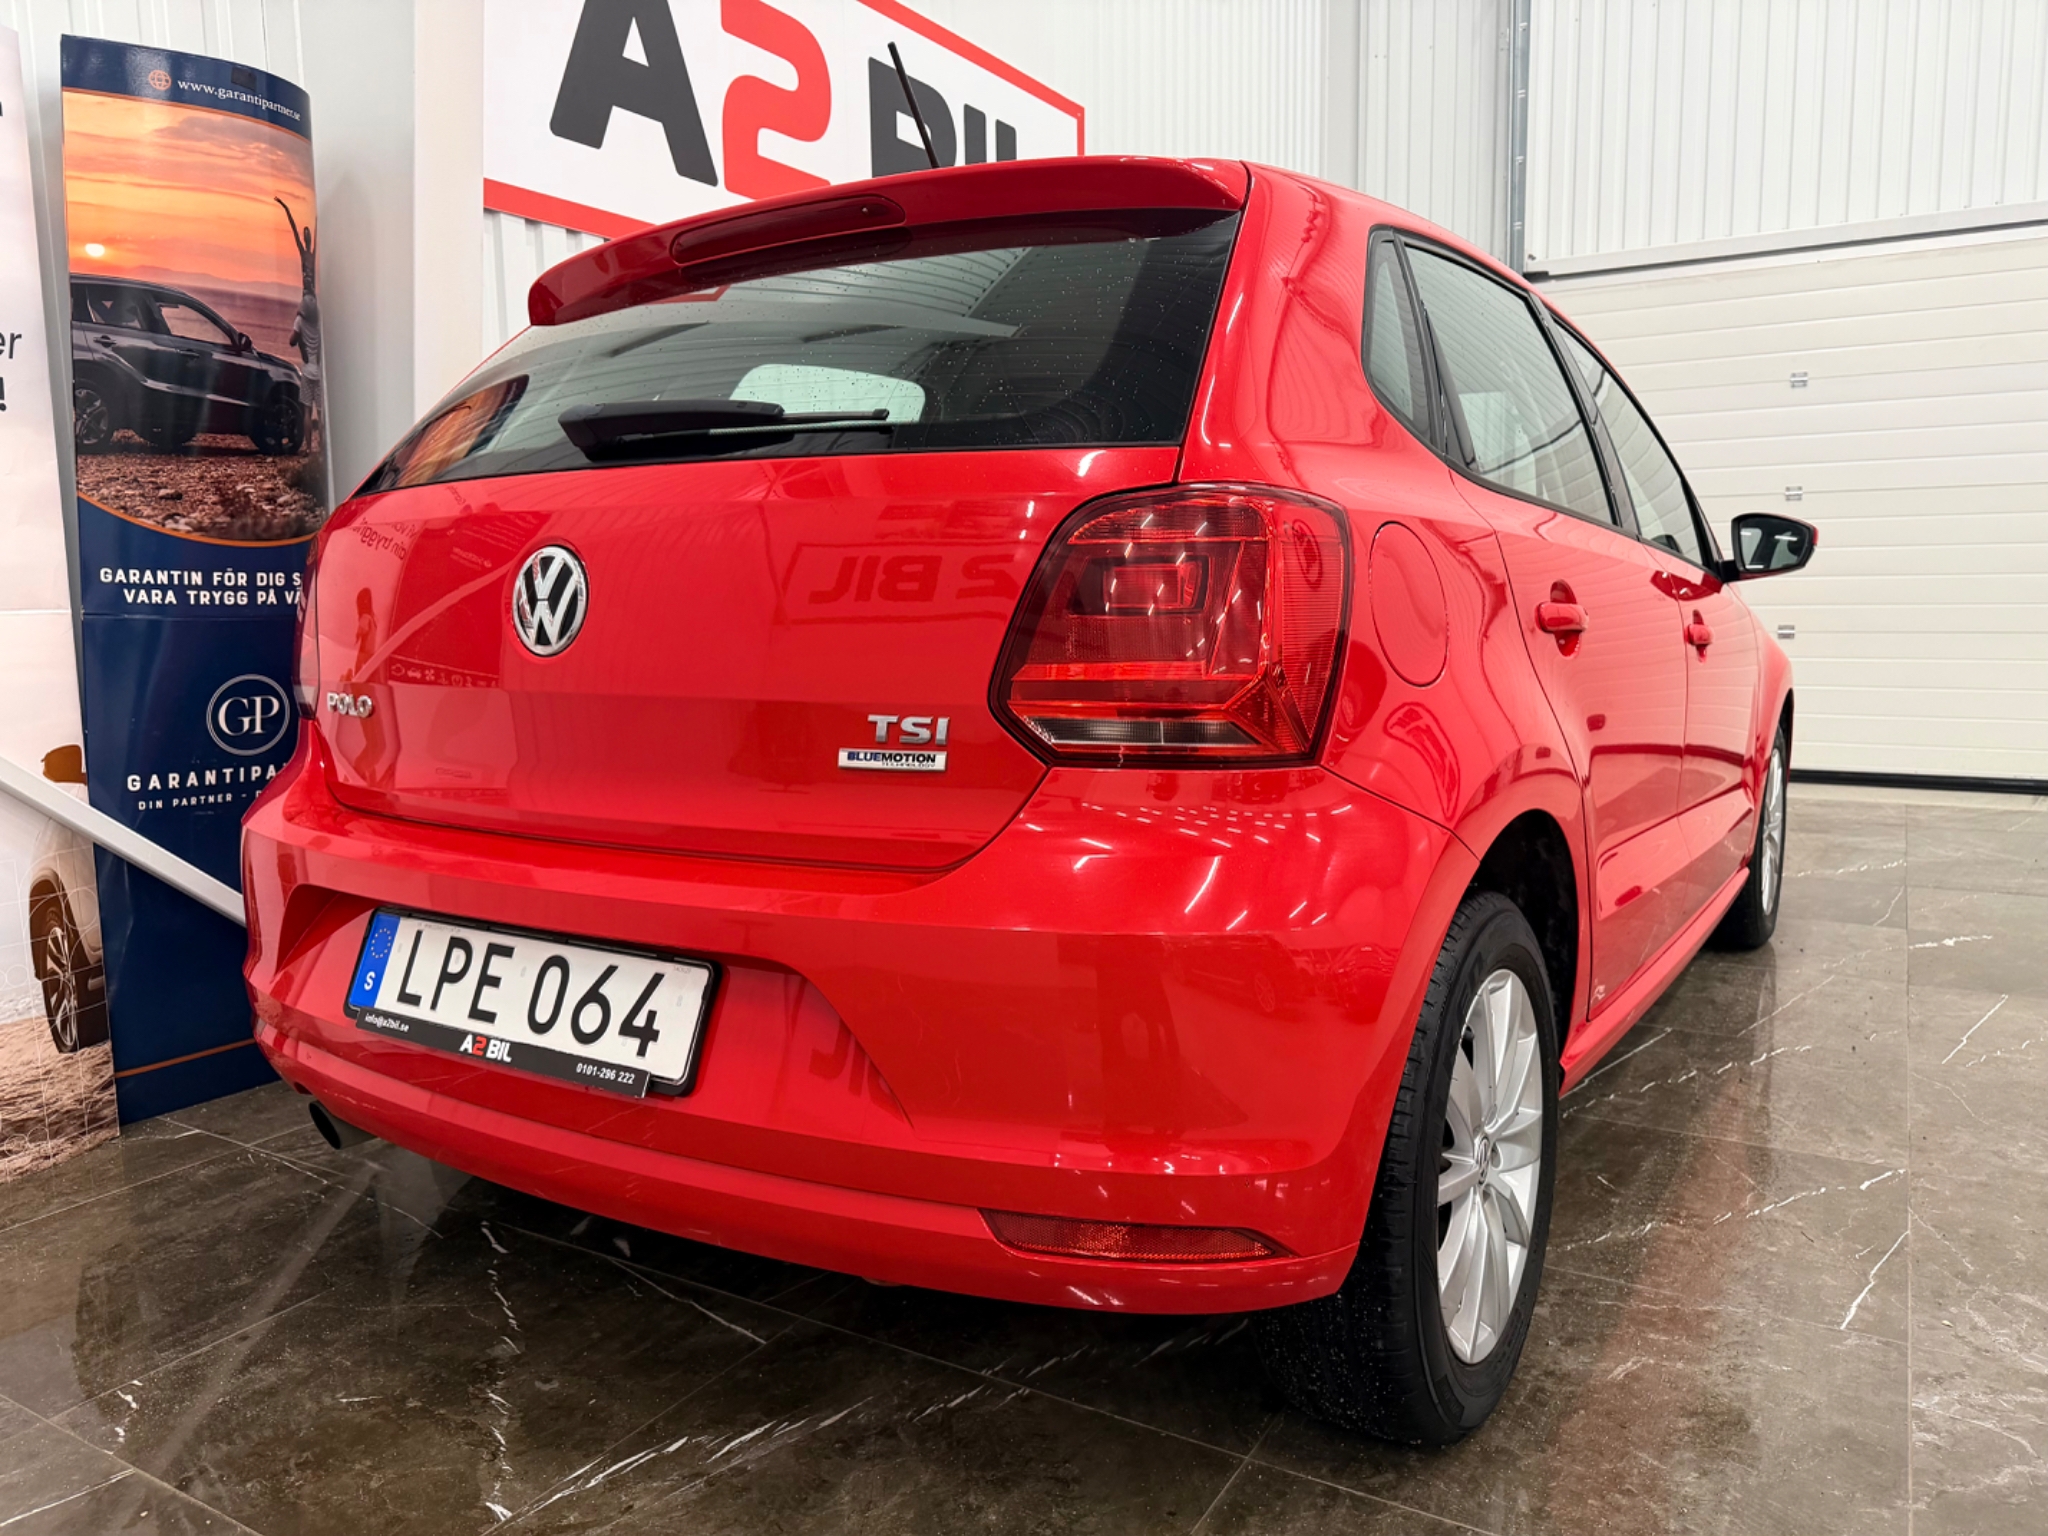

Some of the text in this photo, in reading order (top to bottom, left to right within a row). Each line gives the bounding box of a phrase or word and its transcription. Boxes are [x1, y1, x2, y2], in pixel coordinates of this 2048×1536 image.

[177, 80, 301, 122] www.garantipartner.se
[100, 567, 302, 587] GARANTIN FÖR DIG S
[123, 588, 178, 605] VARA
[186, 590, 249, 606] TRYGG
[257, 588, 278, 605] PÅ
[218, 695, 280, 736] GP
[327, 692, 372, 718] POLO
[867, 714, 950, 745] TSI
[847, 751, 936, 763] BLUEMOTION
[127, 765, 281, 792] GARANTIPA
[138, 800, 164, 811] DIN
[172, 793, 233, 808] PARTNER
[363, 971, 376, 991] S
[396, 930, 665, 1058] LPE 064
[459, 1033, 512, 1063] A2 BIL
[576, 1062, 636, 1085] 0101-296 222
